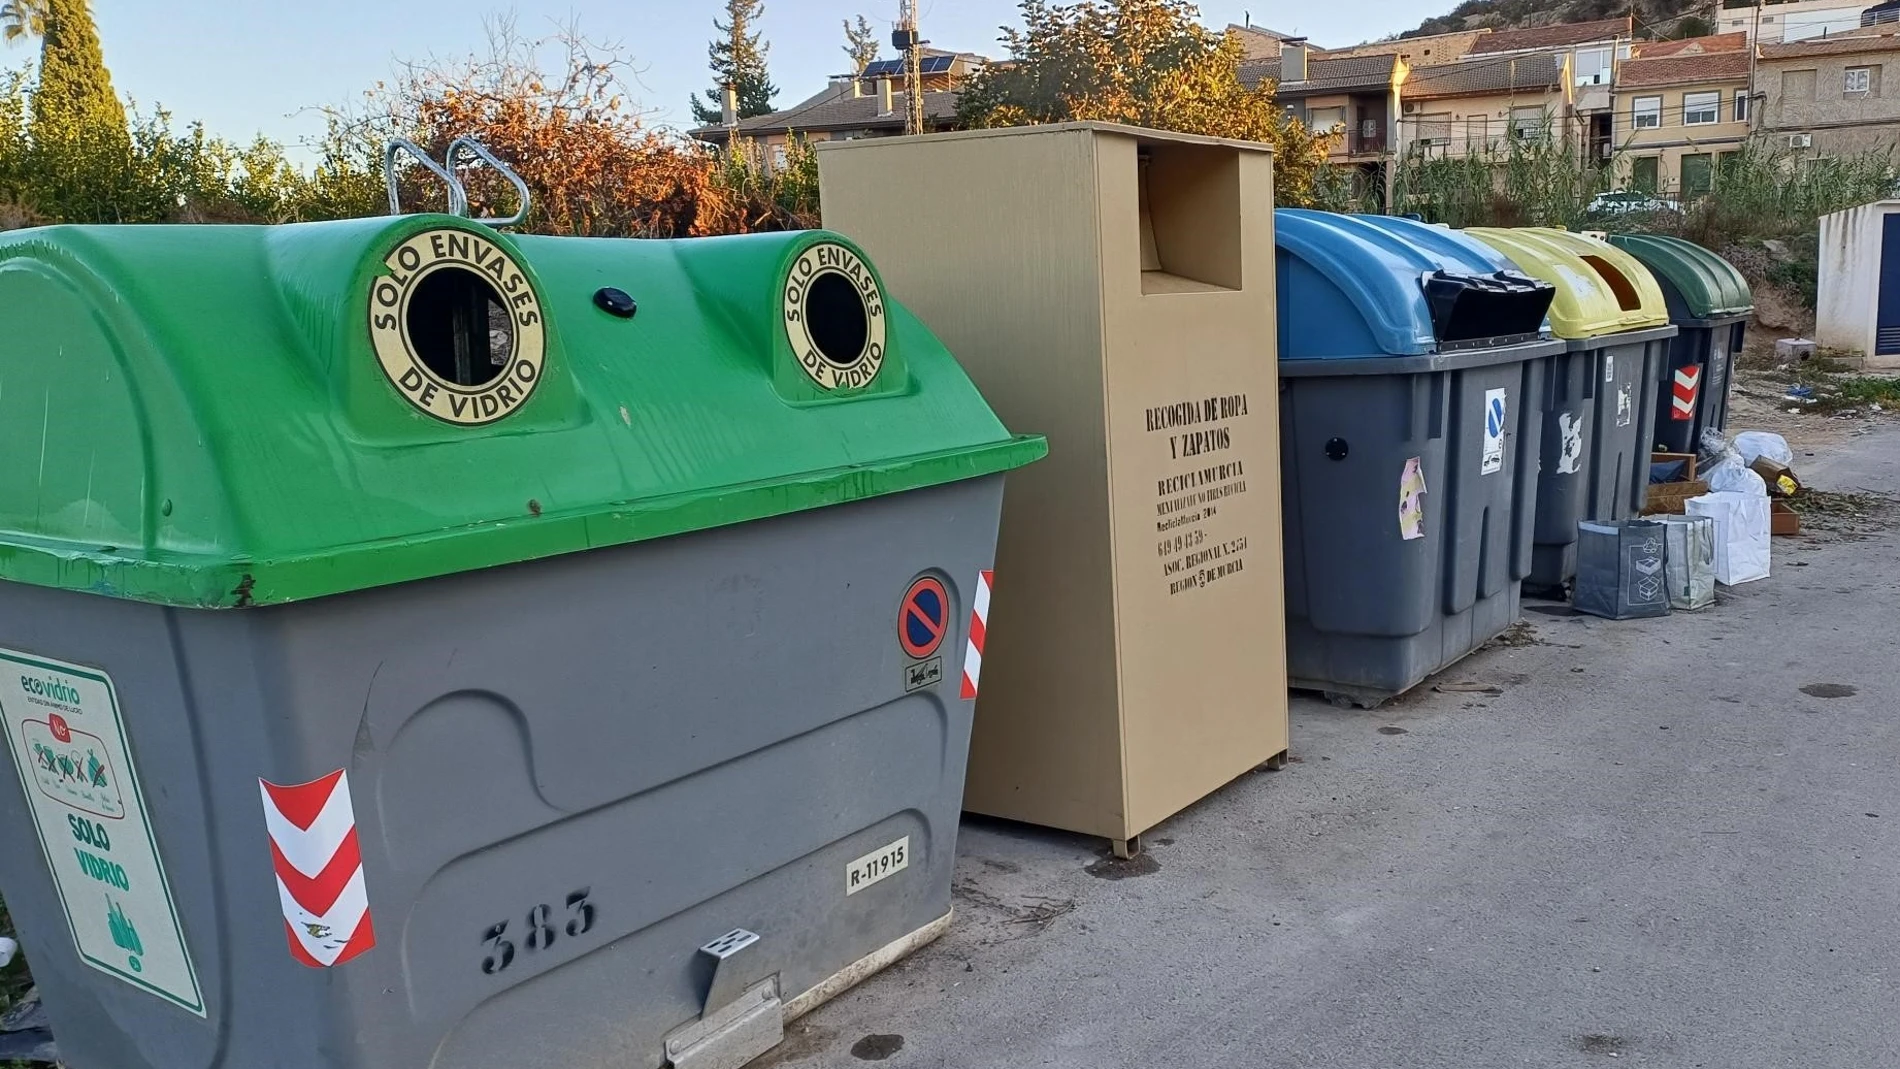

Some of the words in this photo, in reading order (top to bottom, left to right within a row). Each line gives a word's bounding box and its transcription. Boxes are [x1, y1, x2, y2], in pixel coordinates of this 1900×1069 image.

[375, 246, 420, 330] SOLO
[430, 233, 538, 327] ENVASES
[787, 257, 812, 322] SOLO
[817, 247, 882, 317] ENVASES
[803, 348, 826, 380] DE
[832, 342, 882, 388] VIDRIO
[399, 366, 439, 407] DE
[448, 359, 536, 419] VIDRIO
[1146, 400, 1201, 432] RECOGIDA
[1204, 397, 1218, 421] DE
[1220, 393, 1248, 419] ROPA
[1169, 436, 1177, 459] Y
[1182, 427, 1231, 457] ZAPATOS
[1170, 574, 1197, 595] REGION
[1207, 568, 1217, 583] DE
[1217, 558, 1243, 579] MURCIA
[21, 675, 80, 705] ecovidrio
[67, 813, 110, 851] SOLO
[74, 847, 129, 891] VIDRIO
[851, 845, 904, 887] R-11915
[481, 886, 596, 975] 383
